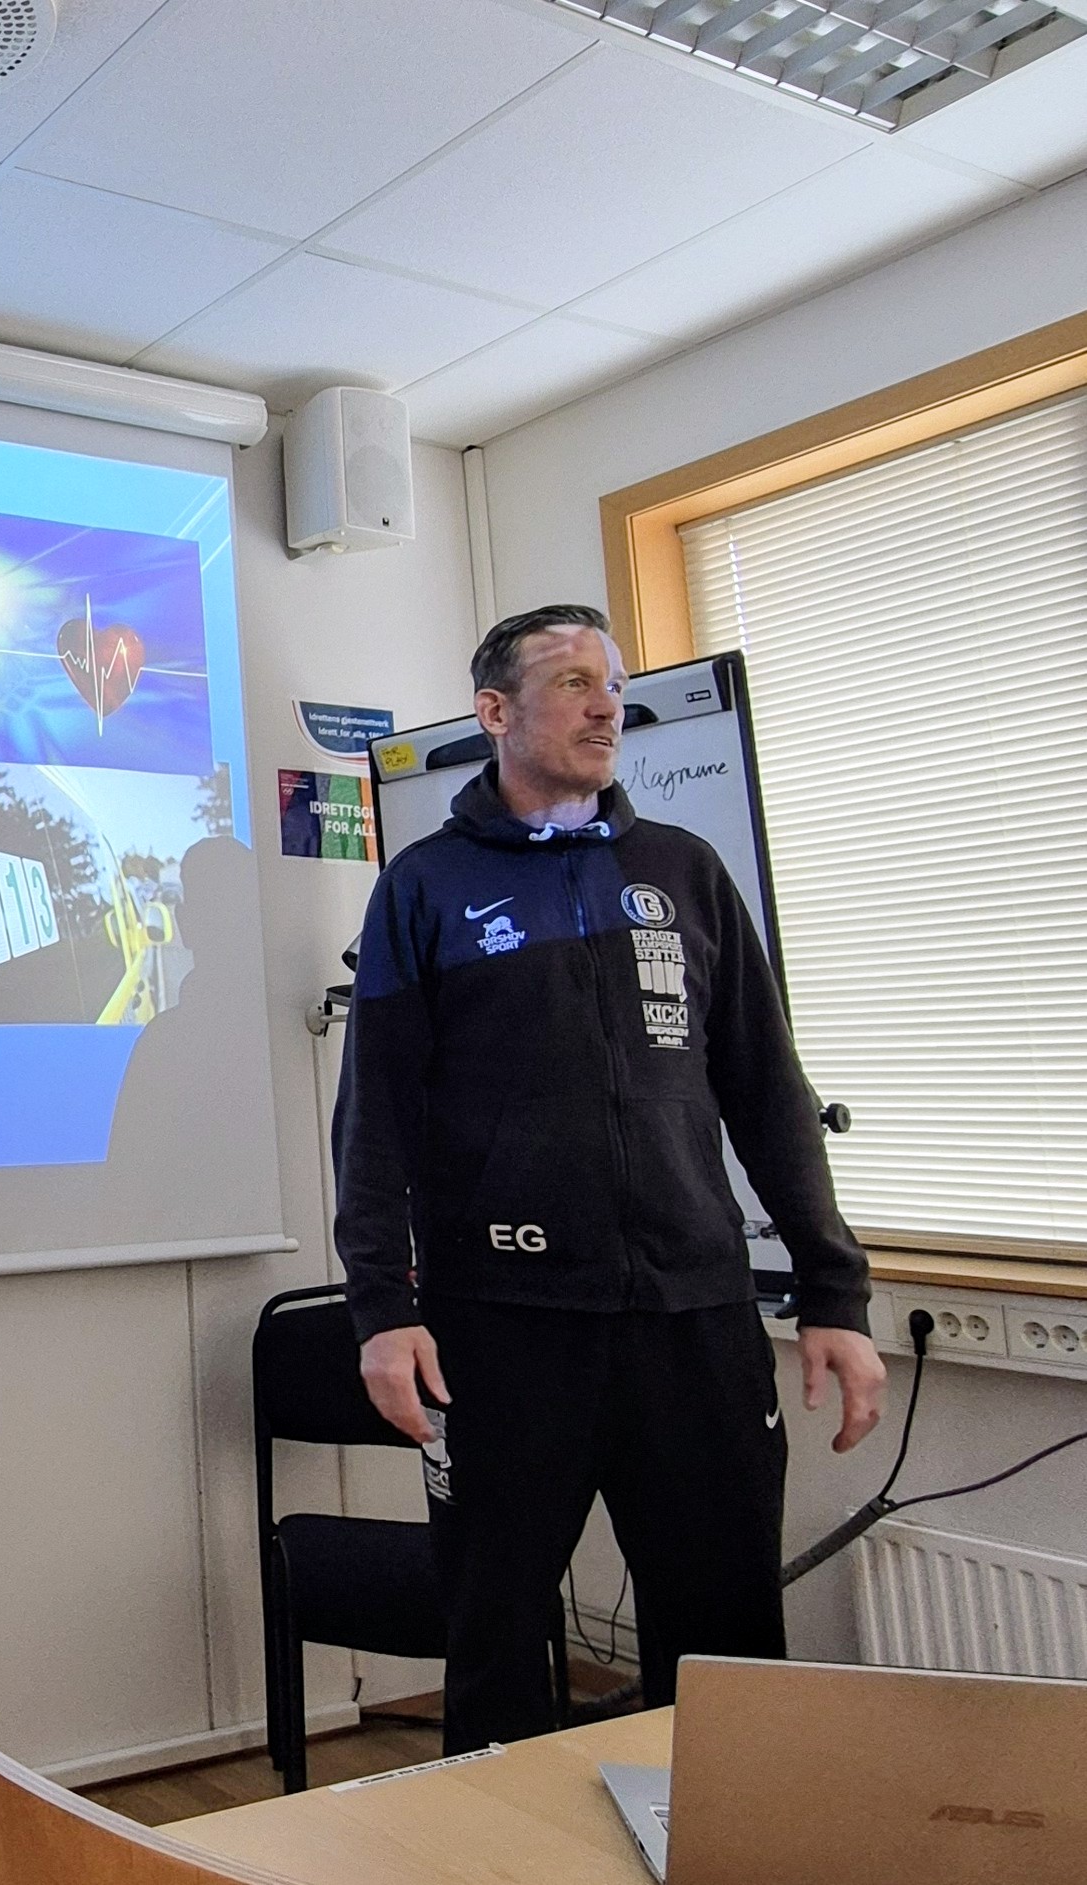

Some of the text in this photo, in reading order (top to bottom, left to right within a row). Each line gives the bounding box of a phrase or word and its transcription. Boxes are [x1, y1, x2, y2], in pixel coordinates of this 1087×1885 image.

[324, 820, 350, 834] FOR
[631, 889, 665, 921] G
[630, 929, 681, 943] BERGEN
[485, 940, 519, 955] SPORT
[635, 948, 686, 964] SENTER
[489, 1223, 548, 1253] EG
